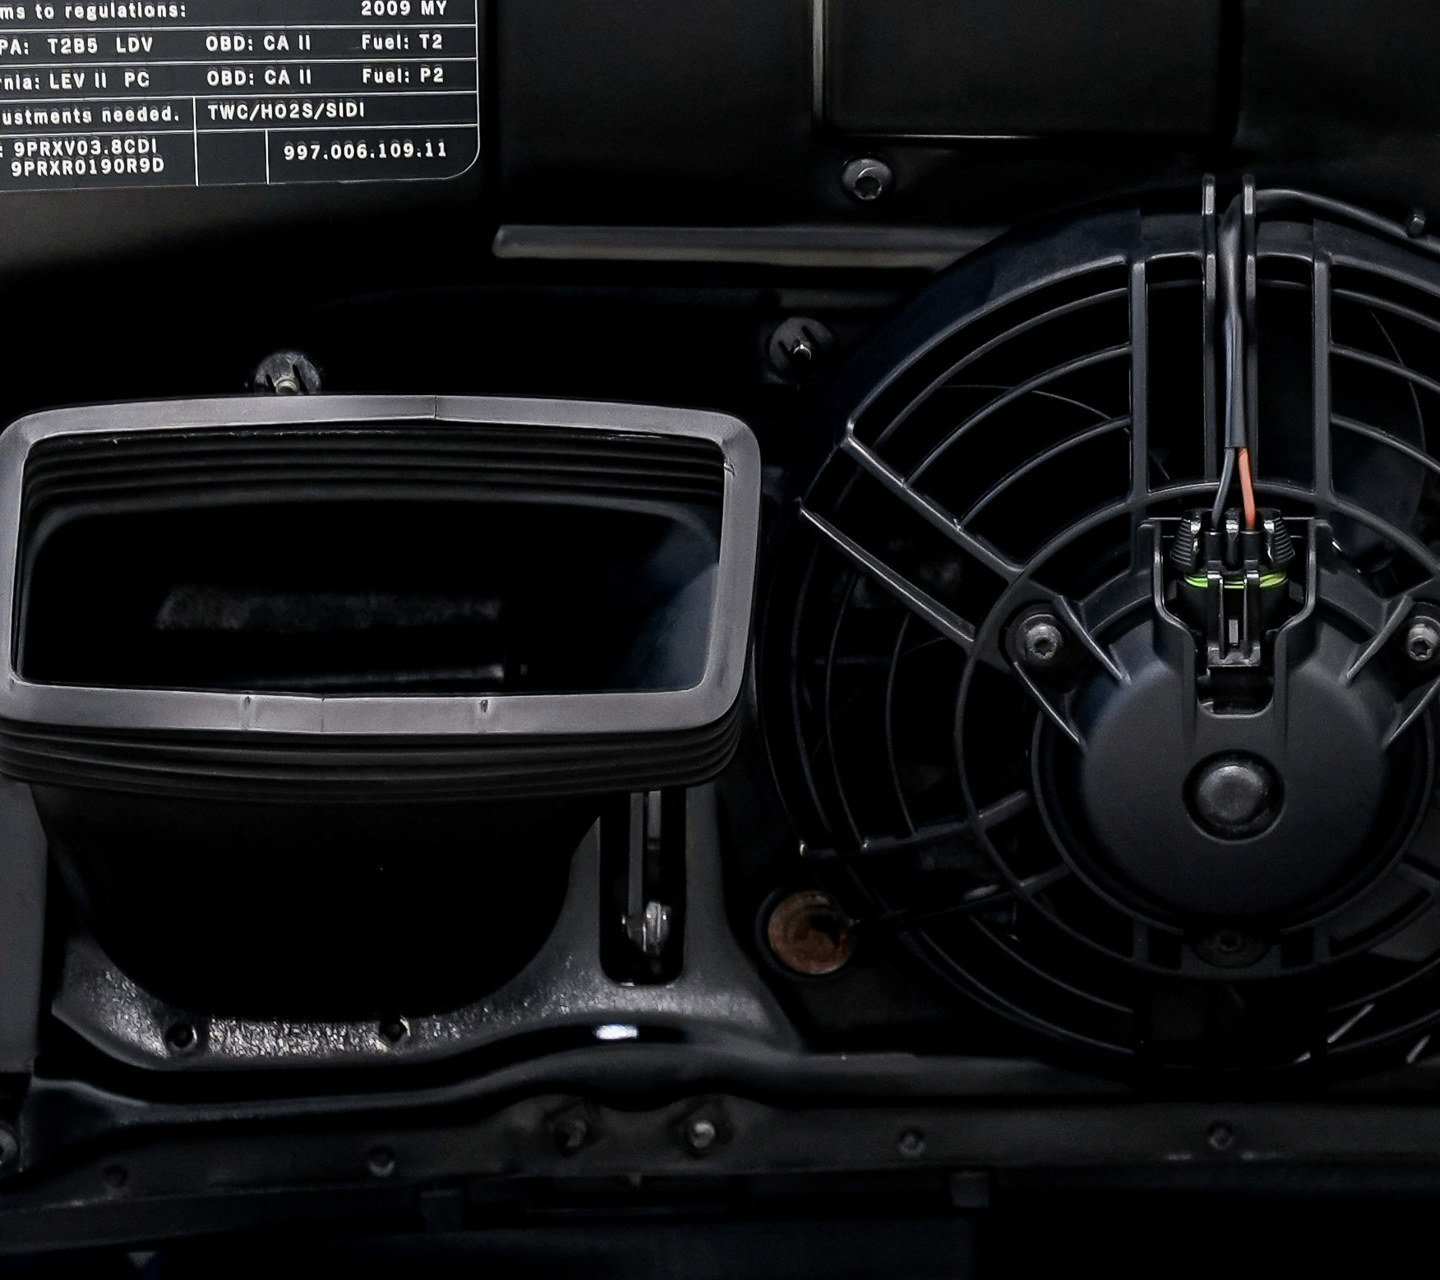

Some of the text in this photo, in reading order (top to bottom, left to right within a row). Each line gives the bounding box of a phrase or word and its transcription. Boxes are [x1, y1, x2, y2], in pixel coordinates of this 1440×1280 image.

[35, 4, 54, 19] to
[65, 2, 186, 21] regulations:
[361, 0, 447, 16] 2009 MY
[48, 38, 98, 55] T2B5
[116, 37, 153, 53] LDV
[206, 34, 253, 51] OBD:
[263, 34, 289, 51] CA
[362, 34, 443, 50] Fuel: T2
[49, 72, 85, 89] LEV
[124, 71, 150, 88] PC
[207, 69, 254, 86] OBD:
[264, 69, 290, 85] CA
[363, 67, 444, 84] Fuel: P2
[102, 106, 179, 123] needed.
[14, 139, 157, 157] 9PRXV03.8CDI
[283, 142, 446, 160] 997.006.109.11
